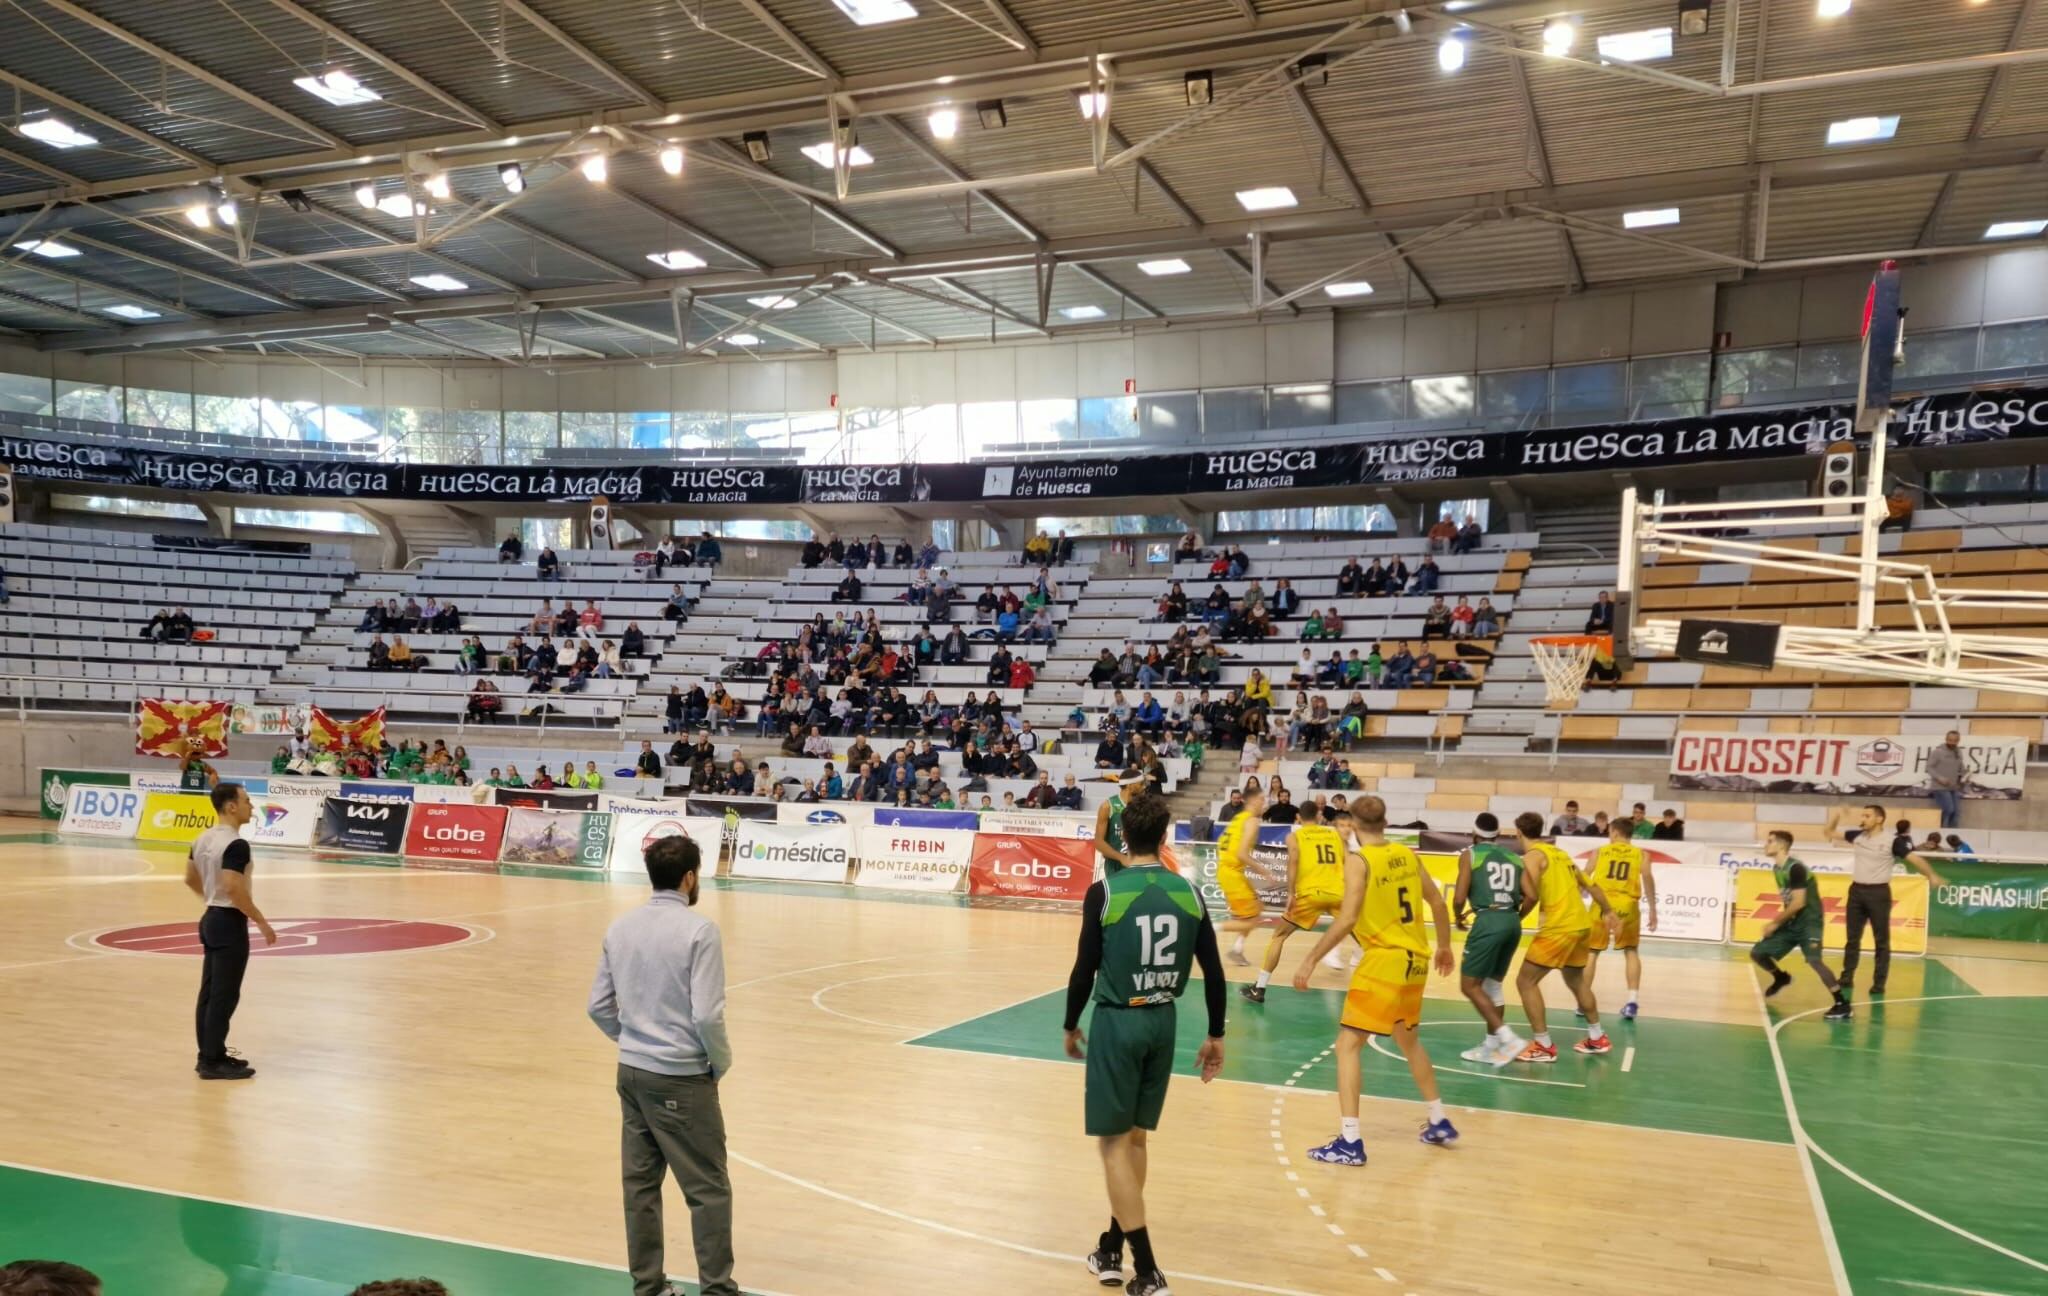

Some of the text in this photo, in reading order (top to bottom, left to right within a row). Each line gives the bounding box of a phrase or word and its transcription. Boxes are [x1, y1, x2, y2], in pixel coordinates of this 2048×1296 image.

[1521, 431, 1664, 464] Huesca
[143, 460, 259, 486] Huesca
[1018, 463, 1118, 480] Ayuntamiento
[1206, 450, 1317, 475] Huesca
[419, 471, 520, 494] Huesca
[671, 469, 765, 488] Huesca
[1016, 481, 1091, 497] de Huesca
[1677, 737, 1850, 776] CROSSFIT
[1913, 746, 2018, 776] HSCA
[74, 789, 138, 818] IBOR
[153, 809, 215, 829] embou
[423, 824, 486, 842] Lobe
[739, 839, 847, 863] doméstica
[891, 839, 945, 853] FRIBIN
[996, 841, 1021, 849] GRUPO
[1316, 844, 1335, 864] 16
[994, 858, 1071, 878] Lobe
[1486, 861, 1515, 892] 20
[1606, 860, 1630, 881] 10
[1398, 886, 1413, 924] 5
[1136, 914, 1178, 966] 12
